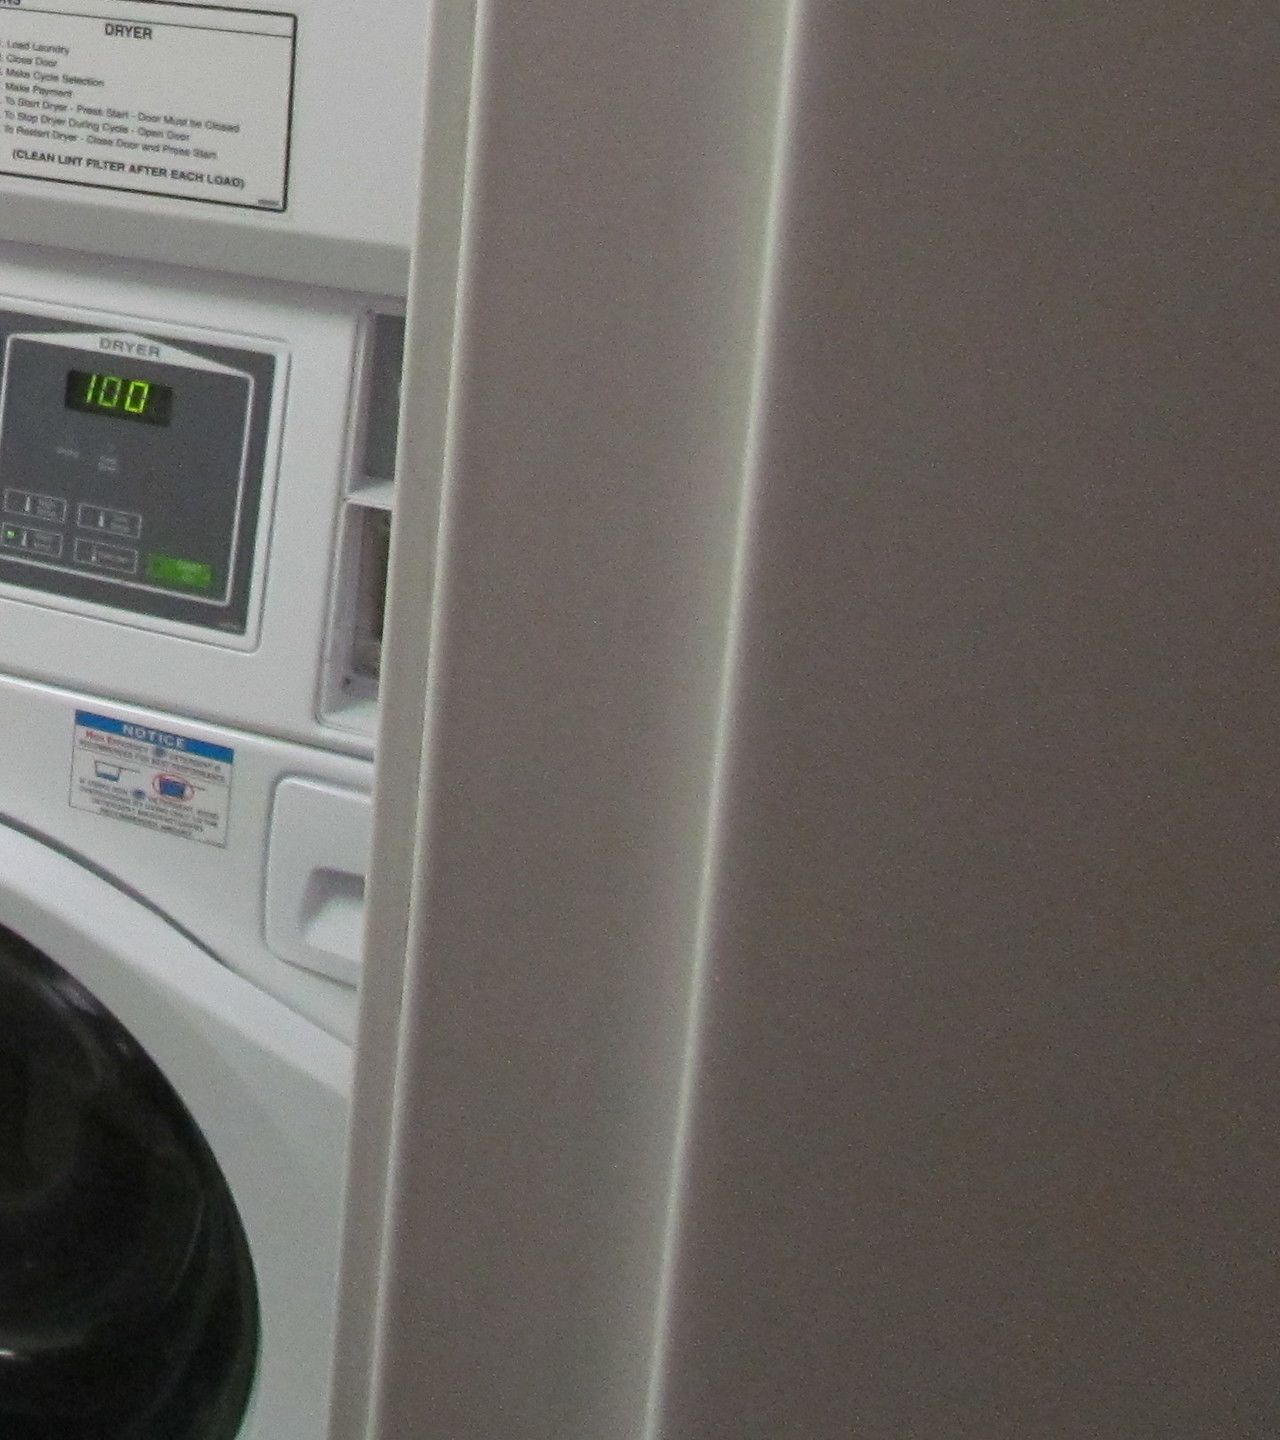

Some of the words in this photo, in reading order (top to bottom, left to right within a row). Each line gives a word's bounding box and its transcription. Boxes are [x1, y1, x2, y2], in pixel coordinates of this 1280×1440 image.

[104, 22, 153, 41] DRYER
[12, 148, 55, 163] (CLEAN
[57, 154, 83, 168] LINT
[86, 158, 126, 173] FILTER
[128, 163, 168, 179] AFTER
[171, 169, 204, 184] EACH
[207, 174, 245, 190] LOAD)
[99, 336, 161, 358] DRYER
[86, 374, 150, 414] 100
[122, 724, 186, 749] NOTICE
